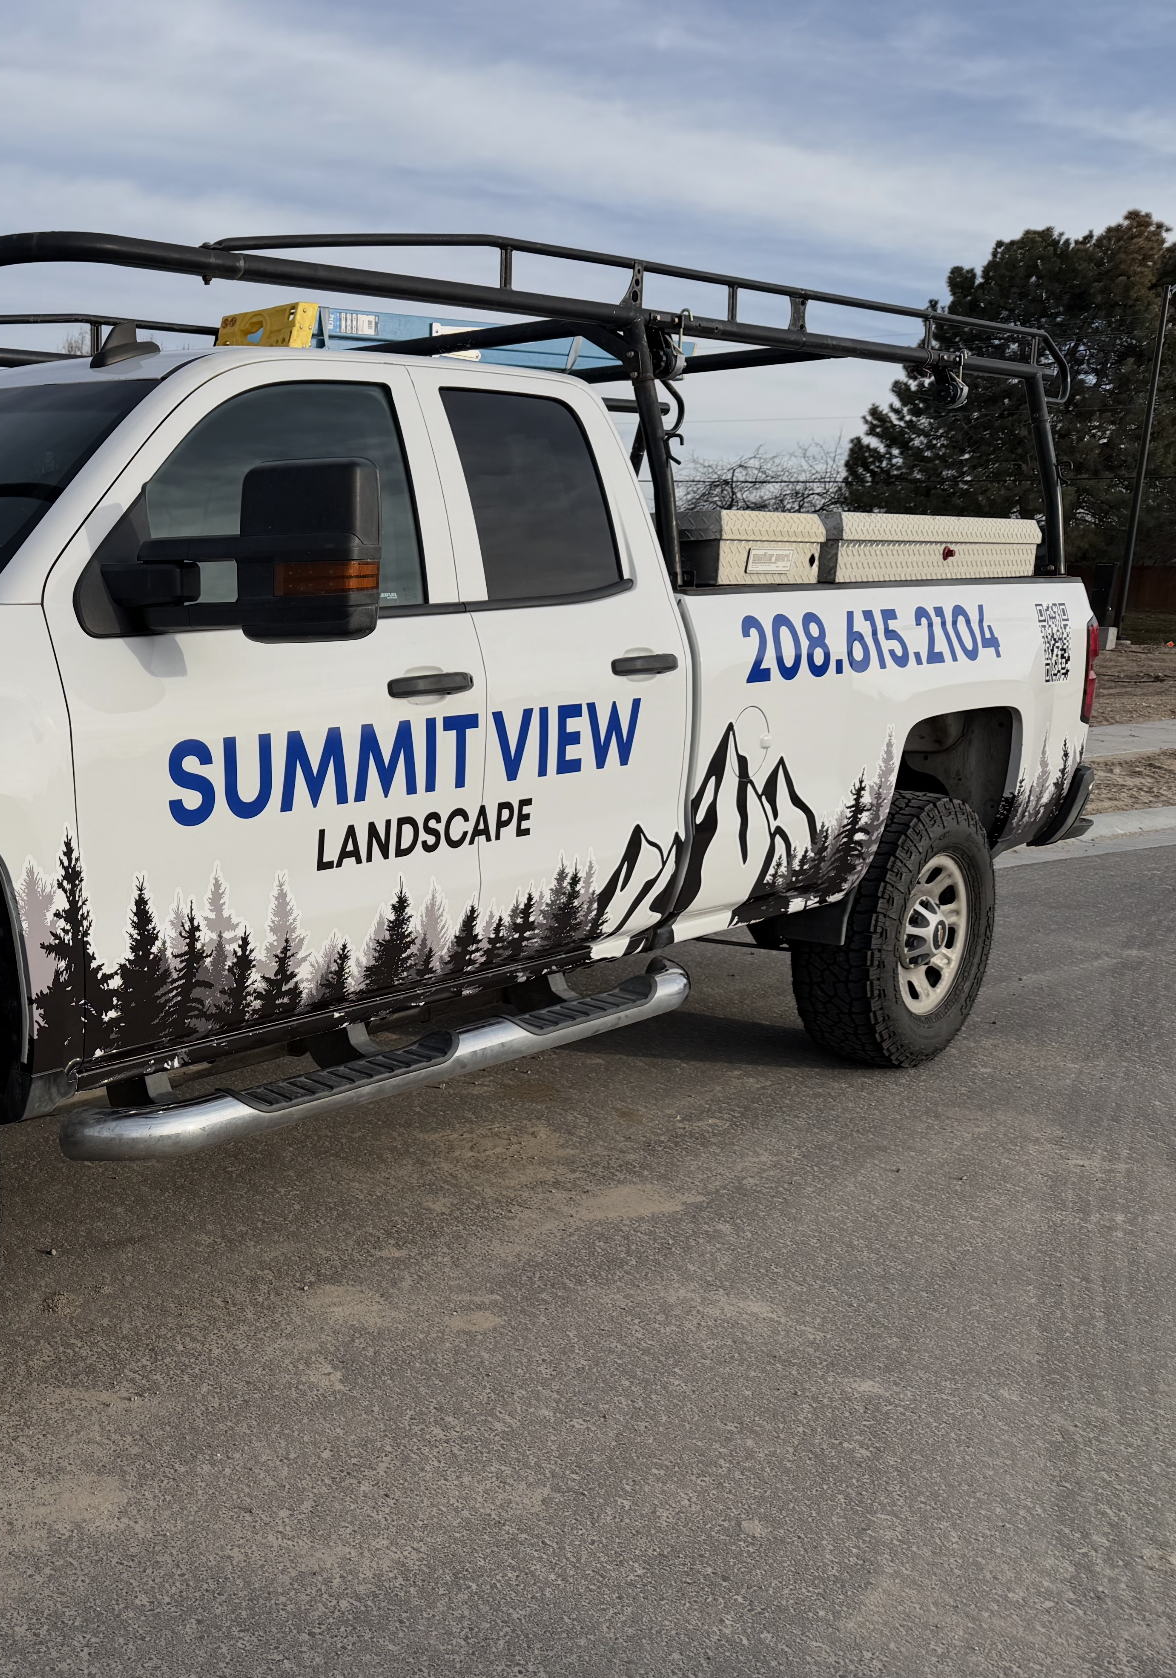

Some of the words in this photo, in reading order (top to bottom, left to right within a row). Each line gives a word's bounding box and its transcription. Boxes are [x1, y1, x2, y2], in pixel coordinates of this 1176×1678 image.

[741, 605, 1000, 684] 208.615.2104
[168, 713, 479, 827] SUMMIT
[492, 697, 642, 782] VIEW
[316, 797, 534, 872] LANDSCAPE
